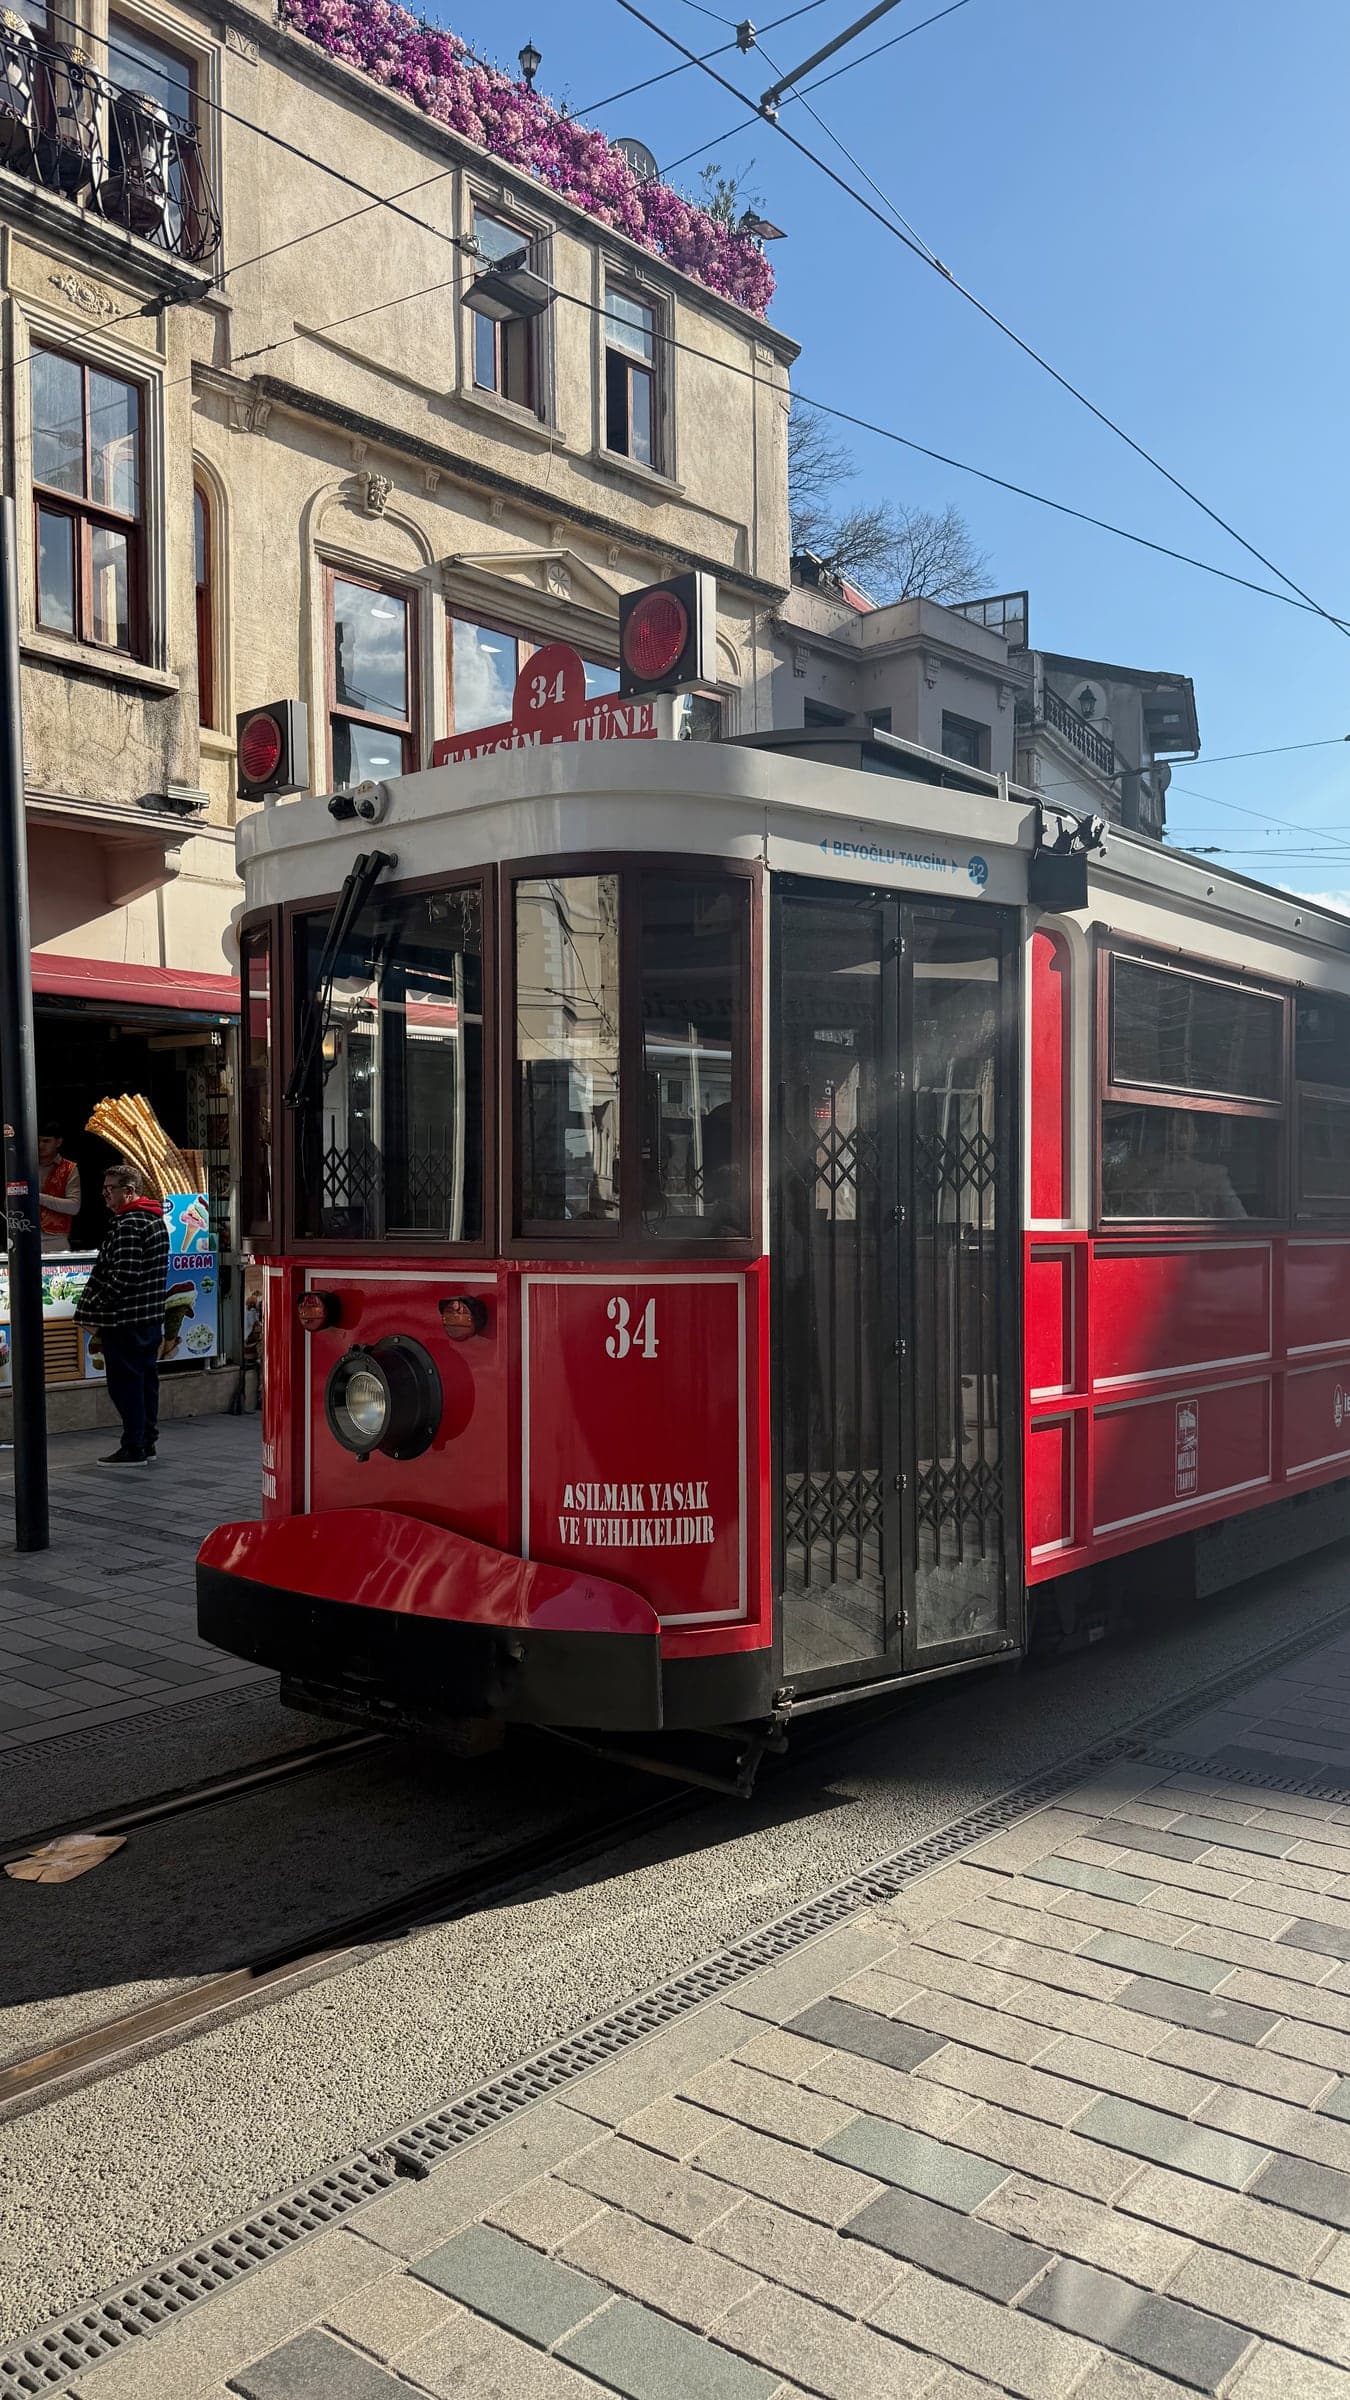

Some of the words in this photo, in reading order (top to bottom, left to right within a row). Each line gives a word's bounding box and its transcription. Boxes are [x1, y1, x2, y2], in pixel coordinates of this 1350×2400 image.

[529, 670, 566, 709] 34
[969, 862, 985, 879] T2
[173, 1254, 213, 1271] CREAM
[605, 1296, 660, 1359] 34
[563, 1482, 644, 1511] ASILMAK
[558, 1516, 580, 1545] VE
[584, 1515, 715, 1546] TEHLIKELIDIR
